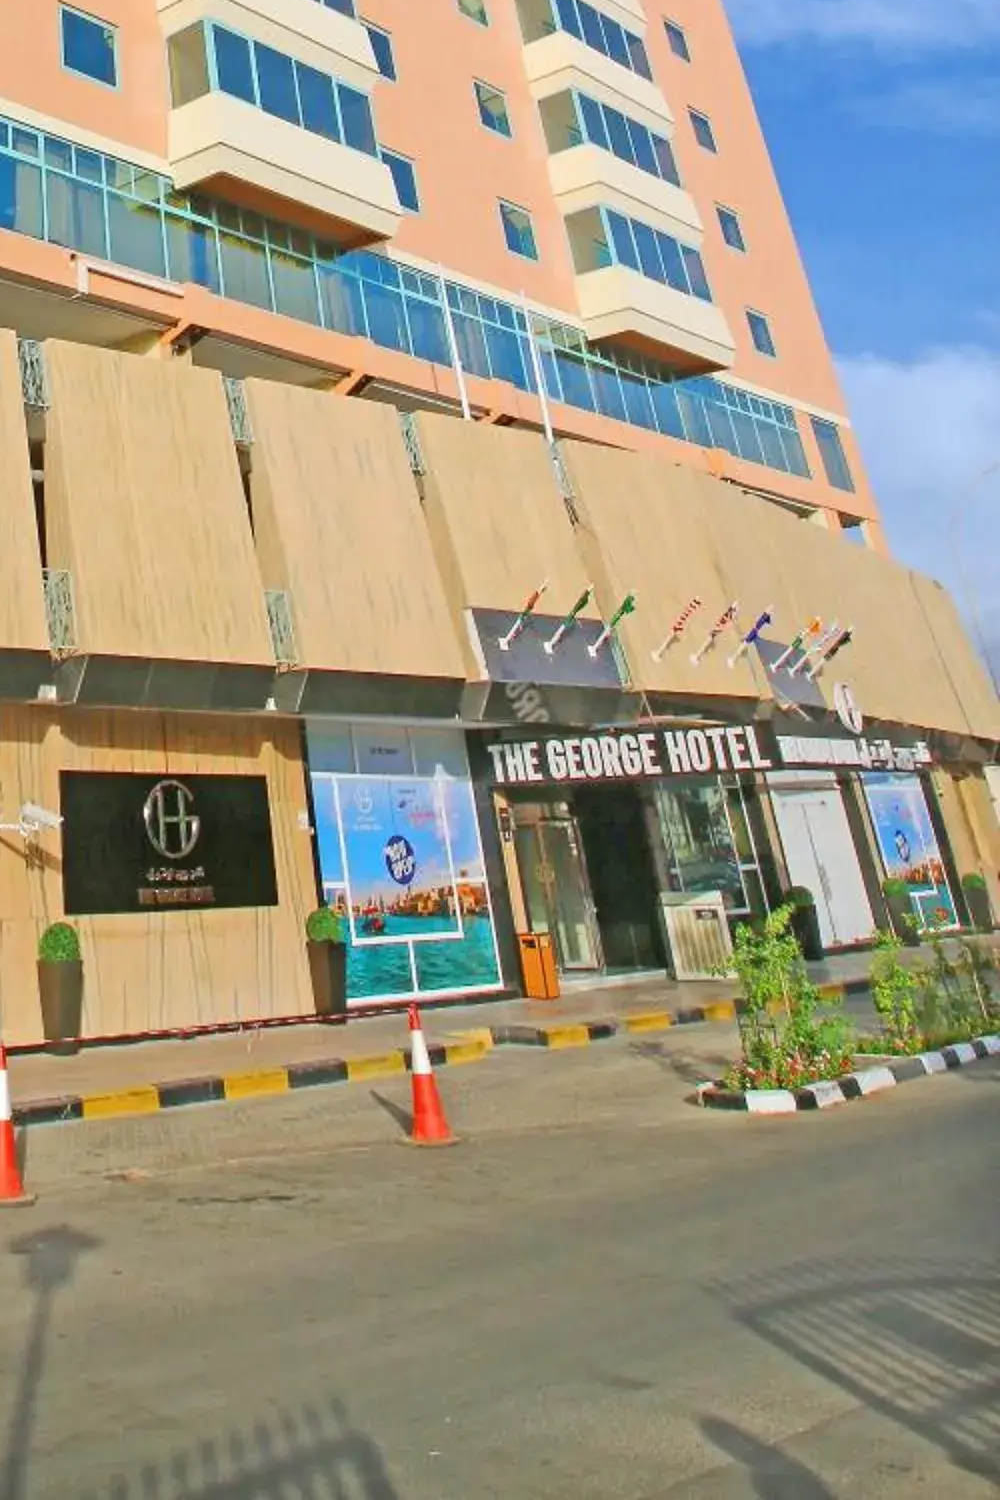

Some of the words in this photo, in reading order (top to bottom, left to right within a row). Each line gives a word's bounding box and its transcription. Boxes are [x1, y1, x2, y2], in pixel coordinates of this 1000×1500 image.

[487, 740, 543, 783] THE
[546, 733, 662, 781] GEORGE
[664, 725, 772, 773] HOTEL
